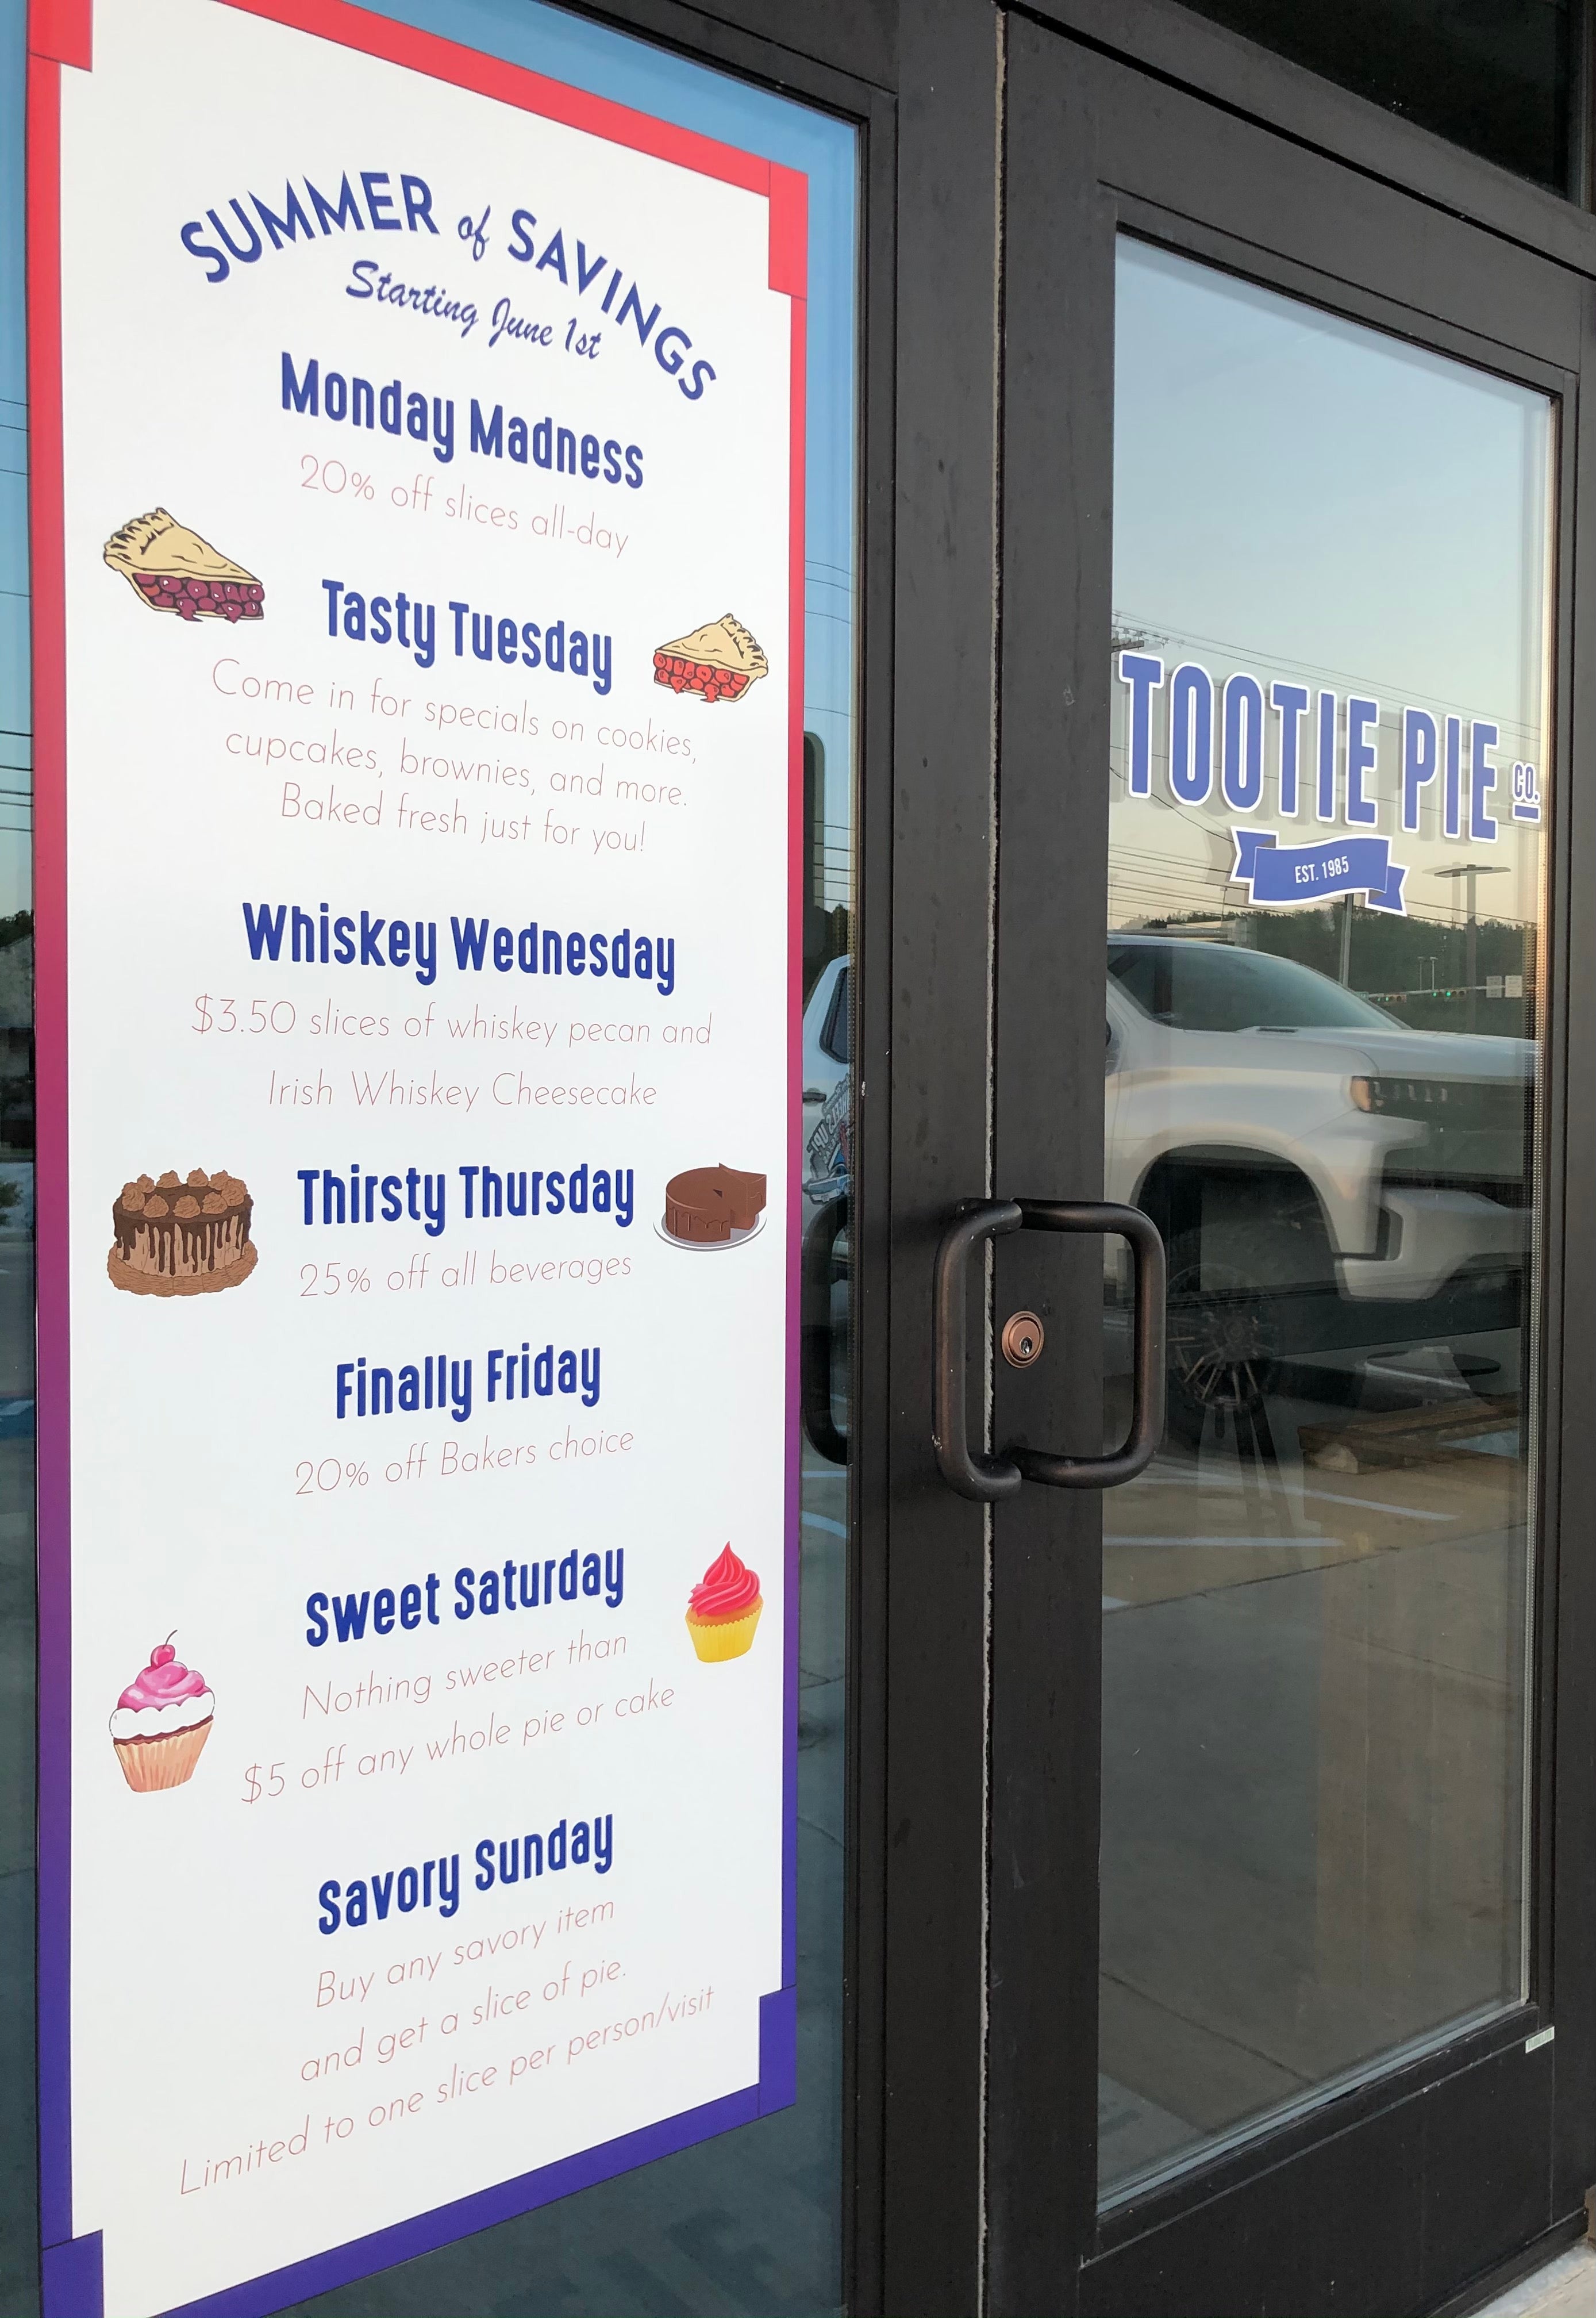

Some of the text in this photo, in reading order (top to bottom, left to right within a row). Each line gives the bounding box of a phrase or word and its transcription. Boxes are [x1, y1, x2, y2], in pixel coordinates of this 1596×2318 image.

[179, 170, 717, 401] SUMMER of SAVINGS
[345, 259, 602, 360] Starting June 1st
[280, 350, 644, 490] Monday Madness
[301, 454, 629, 559] 20% off slices all-day
[321, 578, 612, 696] Tasty Tuesday
[213, 658, 696, 764] Come in for specials on cookies,
[1119, 650, 1541, 843] TOOTIE PIE CO.
[226, 728, 687, 806] cupcakes, brownies, and more.
[282, 781, 645, 855] Baked fresh just for you!
[1294, 856, 1349, 884] EST. 1985
[241, 902, 675, 997] Whiskey Wednesday
[191, 993, 712, 1049] $3.50 slices of whiskey pecan and
[269, 1068, 657, 1113] Irish Whiskey Cheesecake
[297, 1162, 634, 1238] Thirsty Thursday
[299, 1249, 631, 1297] 25% off all beverages
[336, 1342, 601, 1423] Finally Friday
[295, 1425, 634, 1495] 20% off Bakers choice
[306, 1547, 624, 1648] Sweet Saturday
[303, 1629, 626, 1720] Nothing sweeter than
[241, 1677, 675, 1805] $5 off any whole pie or cake
[318, 1813, 613, 1936] Savory Sunday
[316, 1901, 614, 2008] Buy any savory item
[301, 1960, 626, 2081] and get a slice of pie.
[180, 1986, 714, 2195] Limited to one slice per person/visit
